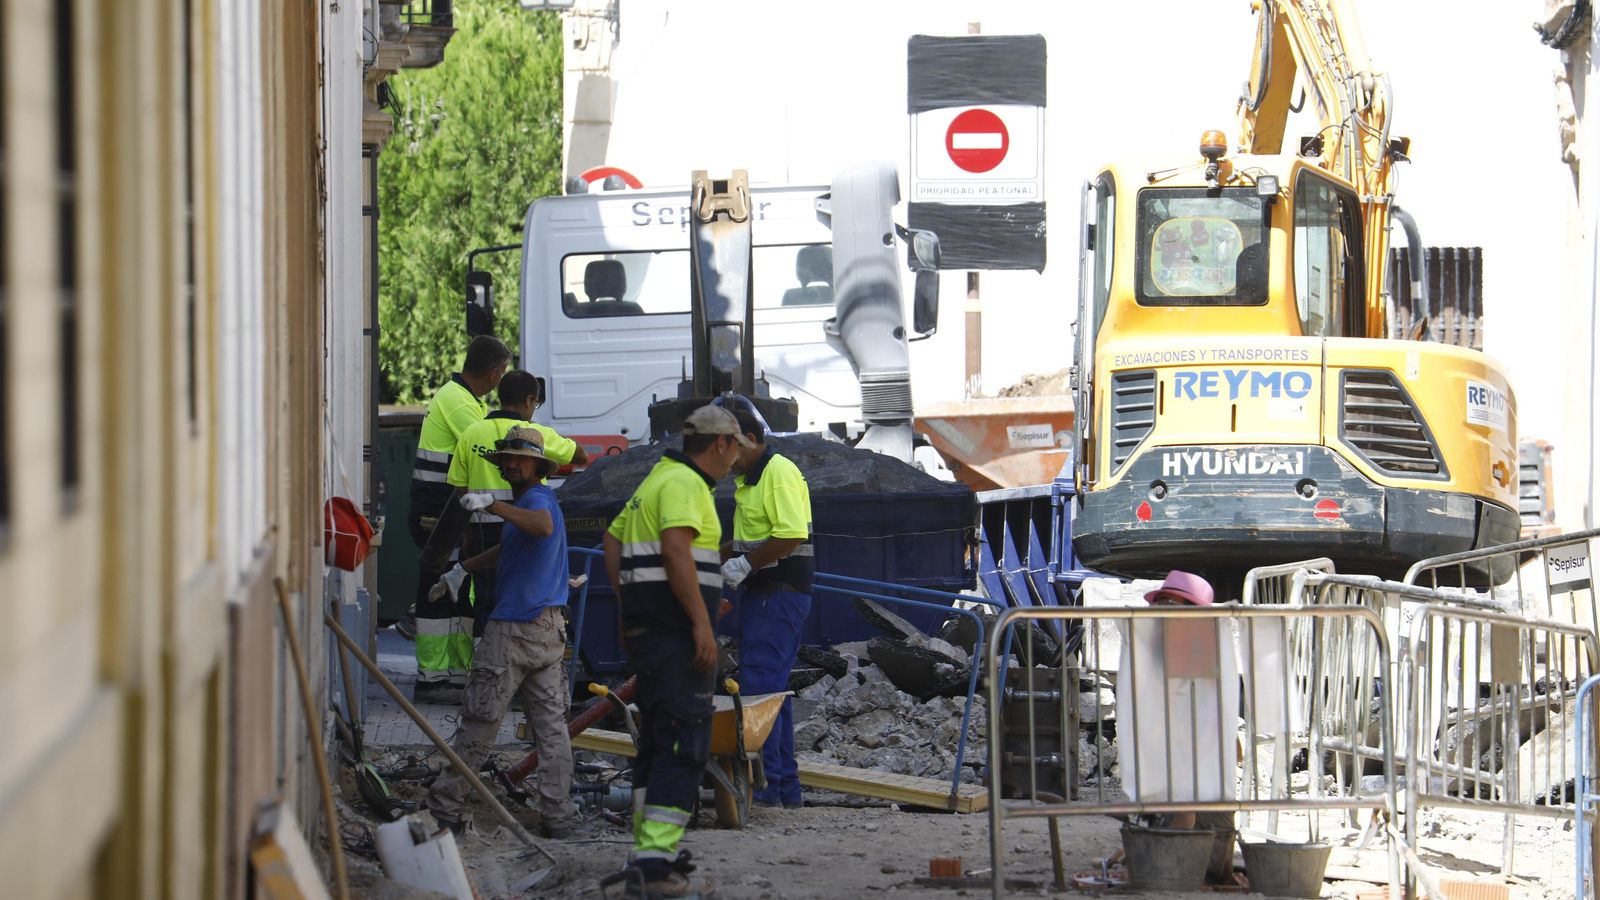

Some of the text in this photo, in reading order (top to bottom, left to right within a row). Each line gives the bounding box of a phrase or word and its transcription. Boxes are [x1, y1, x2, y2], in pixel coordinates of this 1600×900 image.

[920, 186, 1033, 195] PRIORIDAD PEATONAL
[632, 201, 771, 232] Sepr
[1115, 349, 1309, 367] EXCAVACIONES Y TRANSPORTES
[1174, 369, 1312, 401] REYMO
[1468, 386, 1504, 411] REYMO
[1016, 431, 1049, 442] Sepisur
[1162, 451, 1304, 477] HYUNDAI
[1554, 556, 1586, 574] Sepisur
